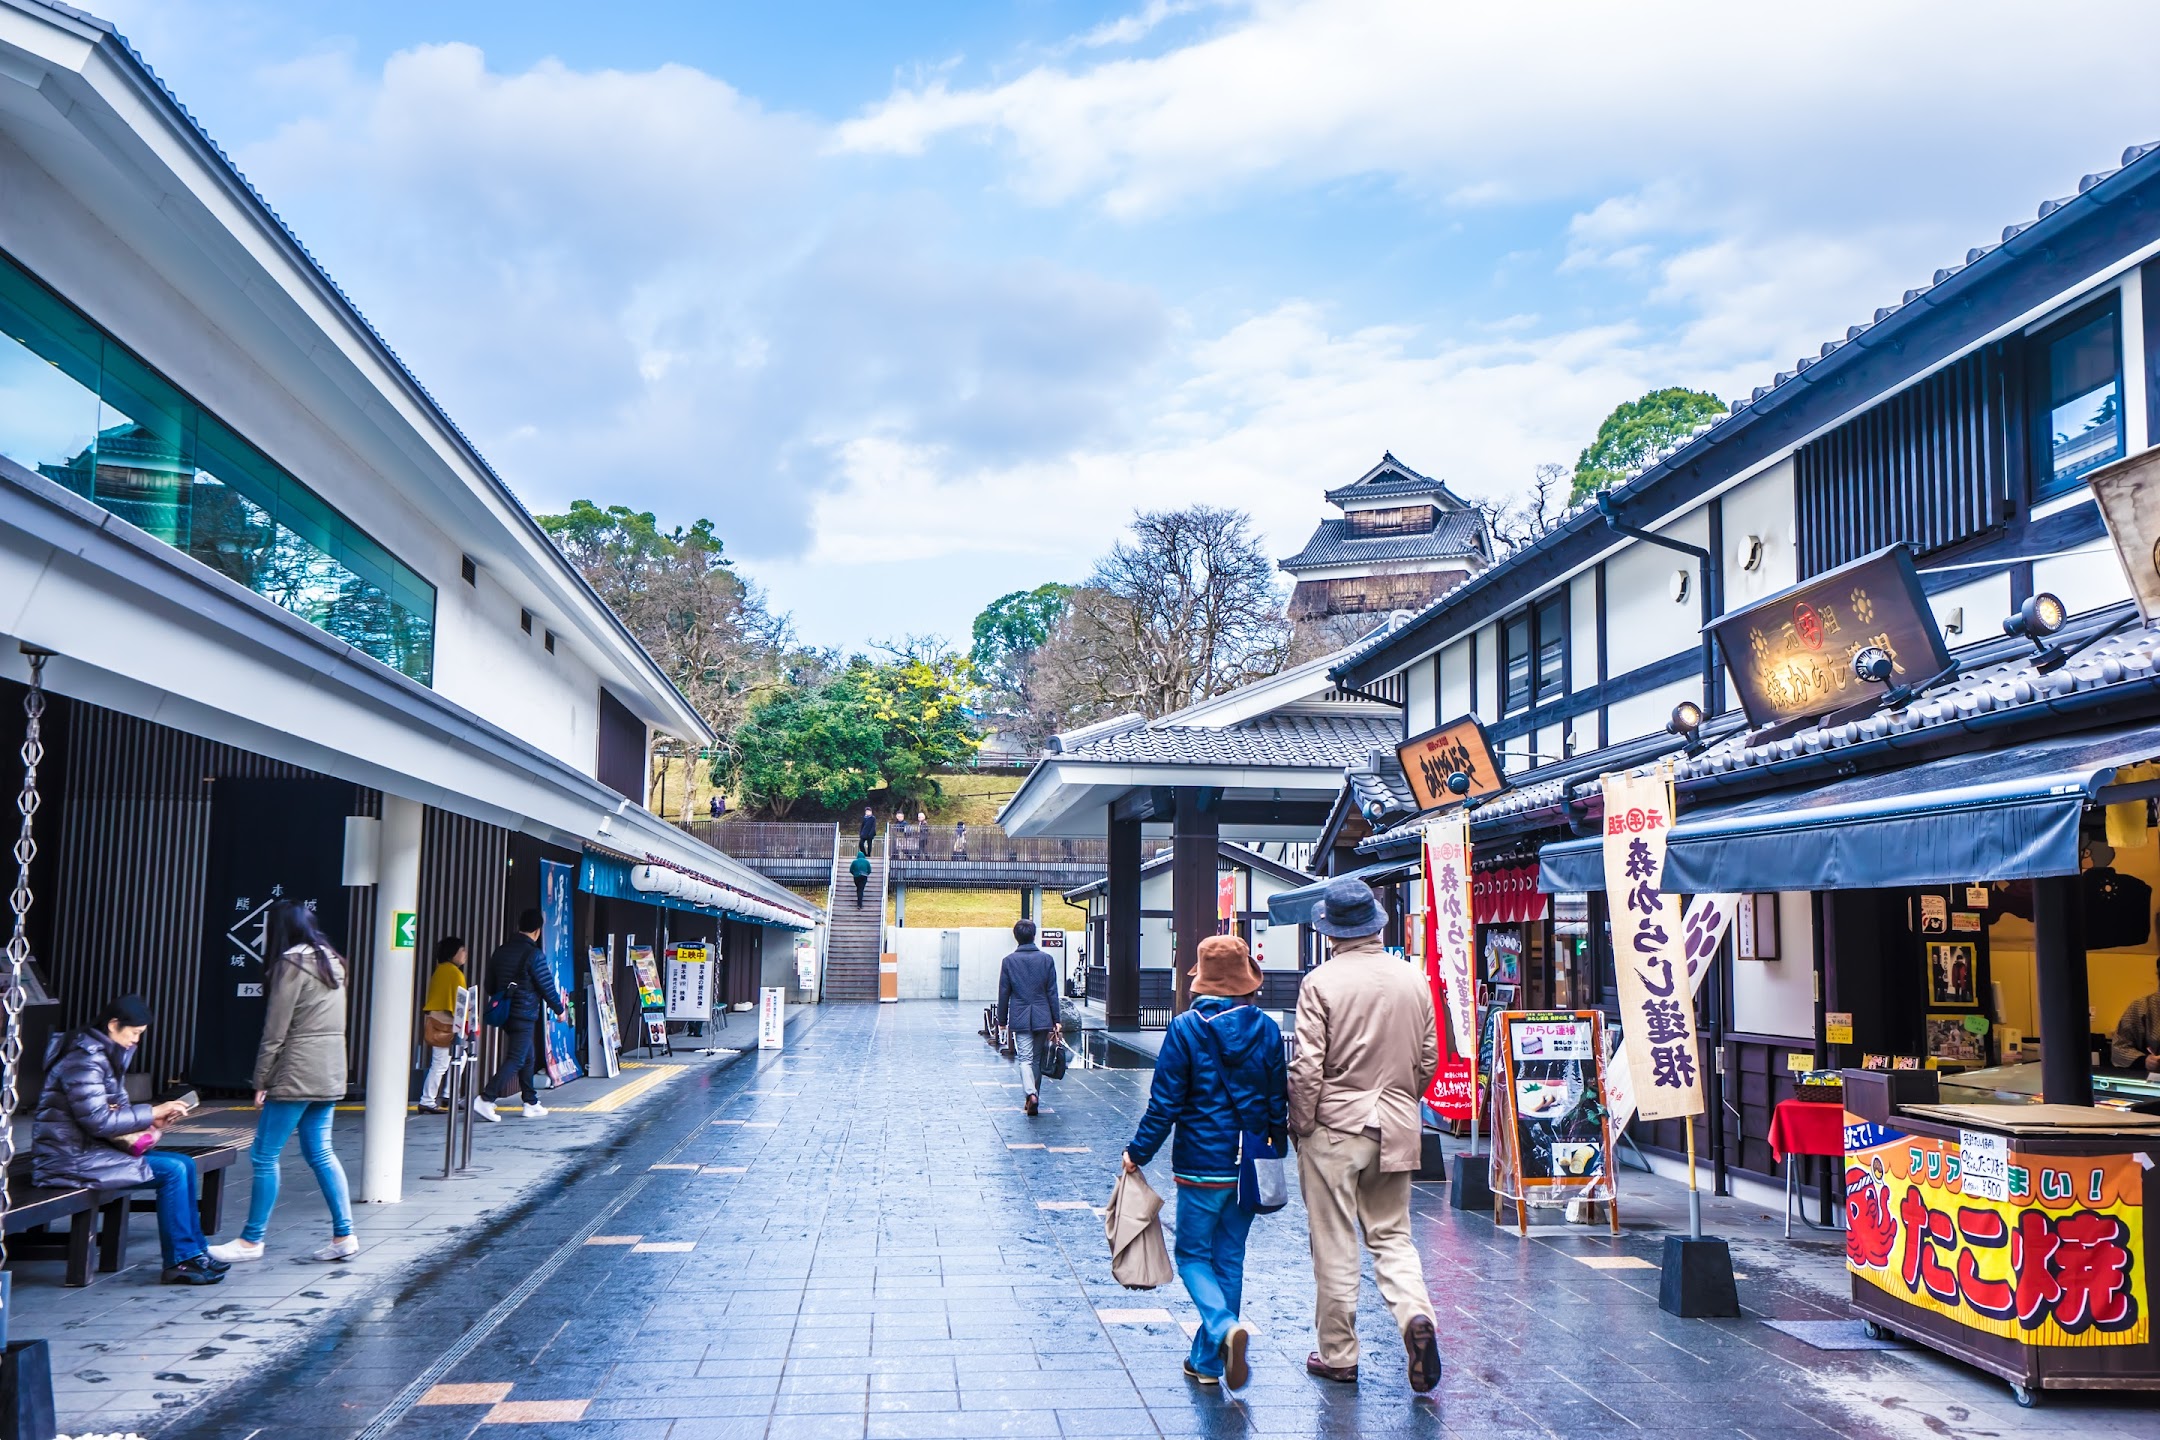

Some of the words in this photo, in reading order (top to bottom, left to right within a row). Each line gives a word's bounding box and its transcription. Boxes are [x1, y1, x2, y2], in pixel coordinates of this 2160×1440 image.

[1763, 633, 1906, 711] 森からし根
[678, 950, 705, 960] 上映中
[1525, 1024, 1576, 1036] からし蓮根
[1902, 1185, 2136, 1332] たこ焼
